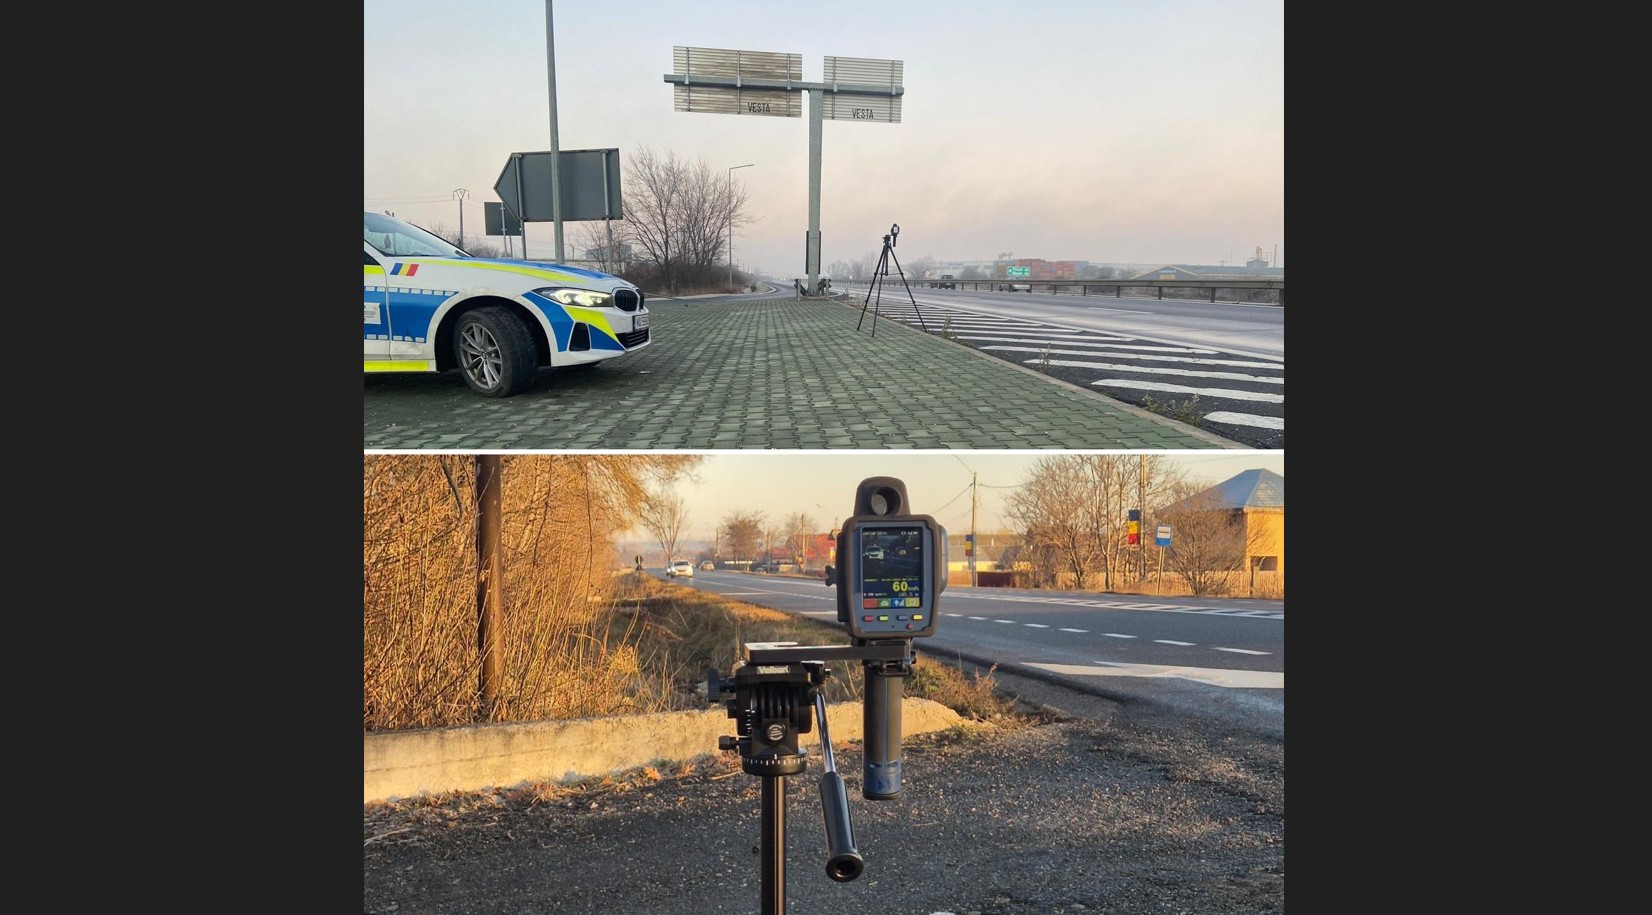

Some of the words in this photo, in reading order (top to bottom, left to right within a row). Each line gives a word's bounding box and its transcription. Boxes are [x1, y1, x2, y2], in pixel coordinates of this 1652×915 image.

[747, 102, 771, 114] VESTA
[852, 108, 874, 119] VESTA
[892, 581, 908, 592] 60
[758, 665, 789, 674] Velbon
